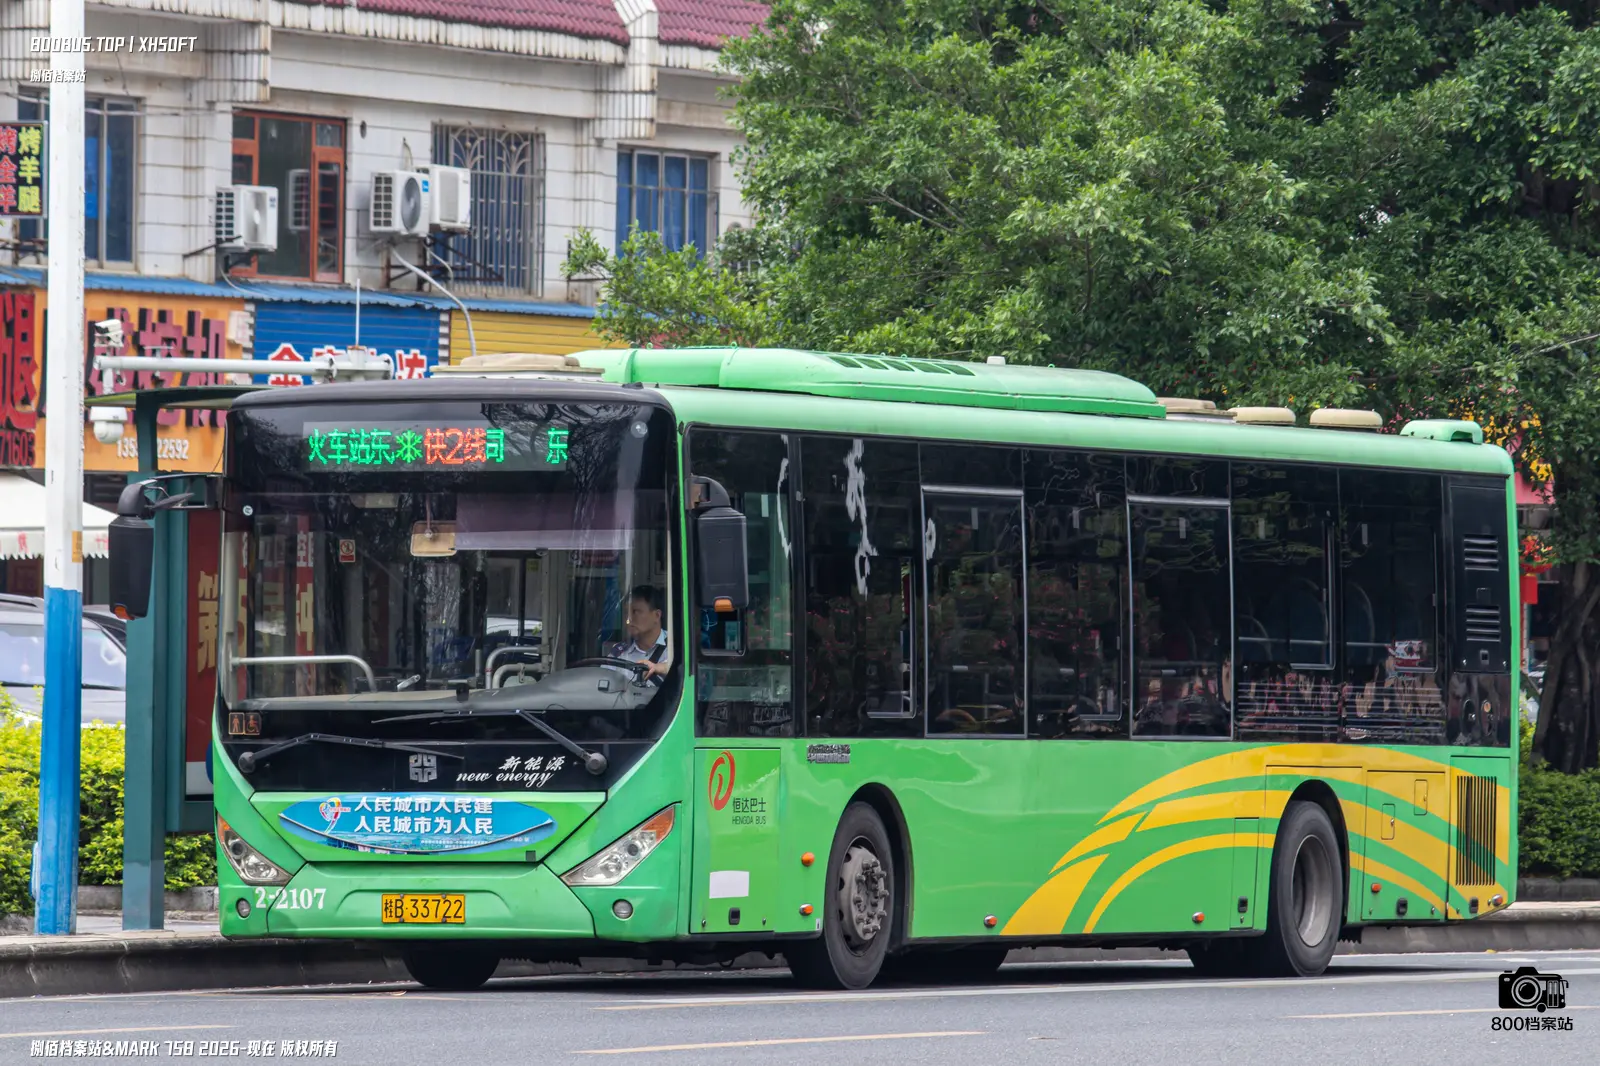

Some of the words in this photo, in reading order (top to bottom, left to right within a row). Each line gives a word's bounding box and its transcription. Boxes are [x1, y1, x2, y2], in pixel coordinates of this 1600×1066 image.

[18, 126, 42, 213] 烤羊腿
[308, 428, 394, 465] 火车站东
[424, 428, 487, 465] 快2线
[499, 756, 565, 772] 新能源
[456, 771, 493, 782] new
[495, 770, 555, 788] energy
[354, 797, 493, 815] 人民城市人民建
[732, 797, 767, 813] 恒达巴士
[354, 816, 493, 835] 人民城市为人民
[732, 816, 753, 825] HENGDA
[755, 816, 767, 825] BUS
[254, 887, 327, 910] 2-2107
